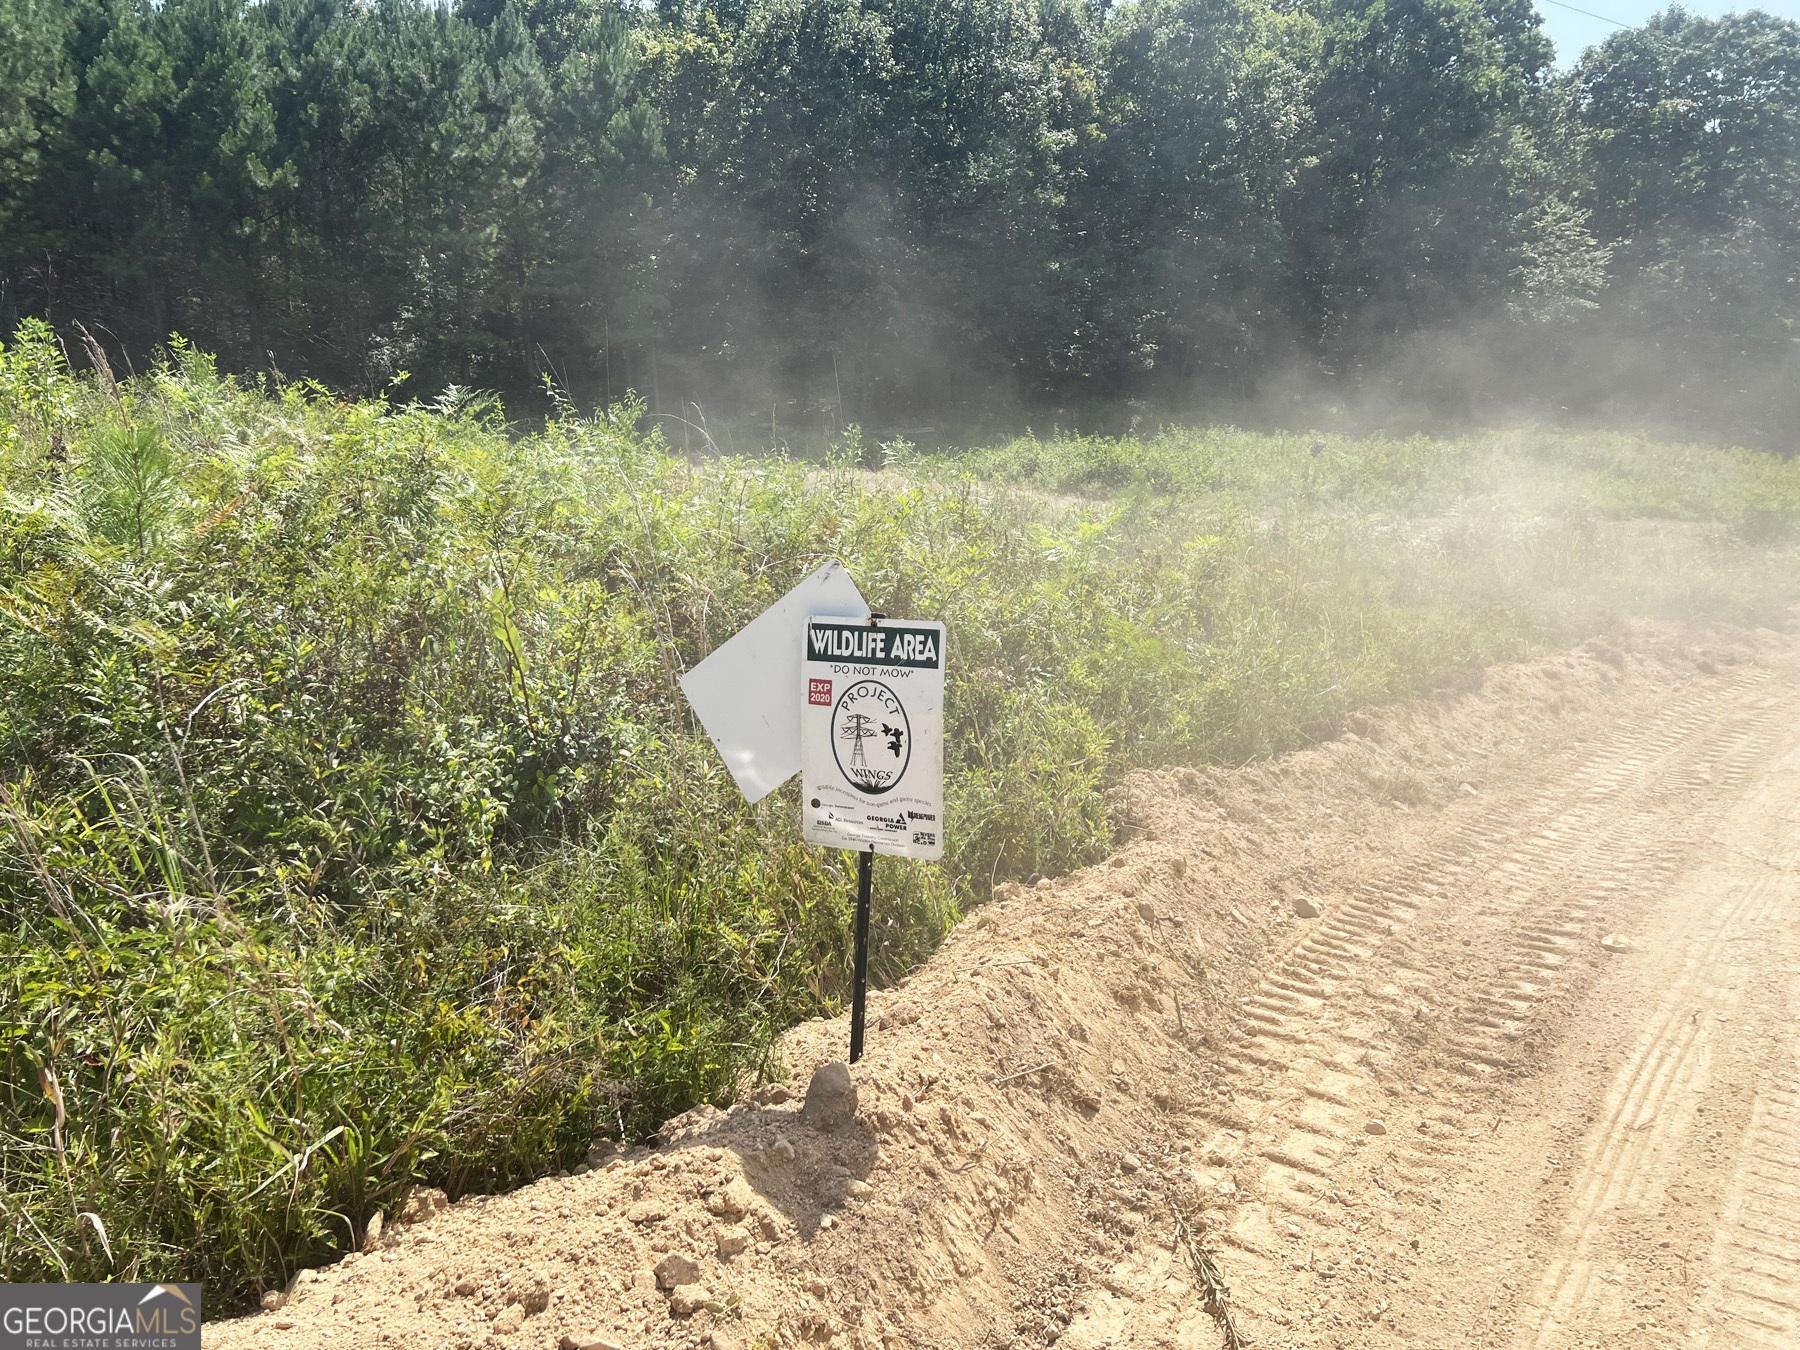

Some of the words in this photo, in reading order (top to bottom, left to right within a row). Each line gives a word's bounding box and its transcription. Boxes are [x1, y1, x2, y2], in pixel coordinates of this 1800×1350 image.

[810, 629, 886, 659] WILDLIFE
[890, 633, 937, 661] AREA
[853, 666, 877, 676] NOT
[810, 682, 831, 692] EXP
[810, 692, 831, 703] 2020
[841, 686, 900, 714] PROJECT
[850, 767, 893, 781] WINGS
[914, 797, 932, 807] species
[817, 819, 832, 827] USDA
[867, 815, 894, 824] GEORGIA
[885, 823, 907, 831] POWER
